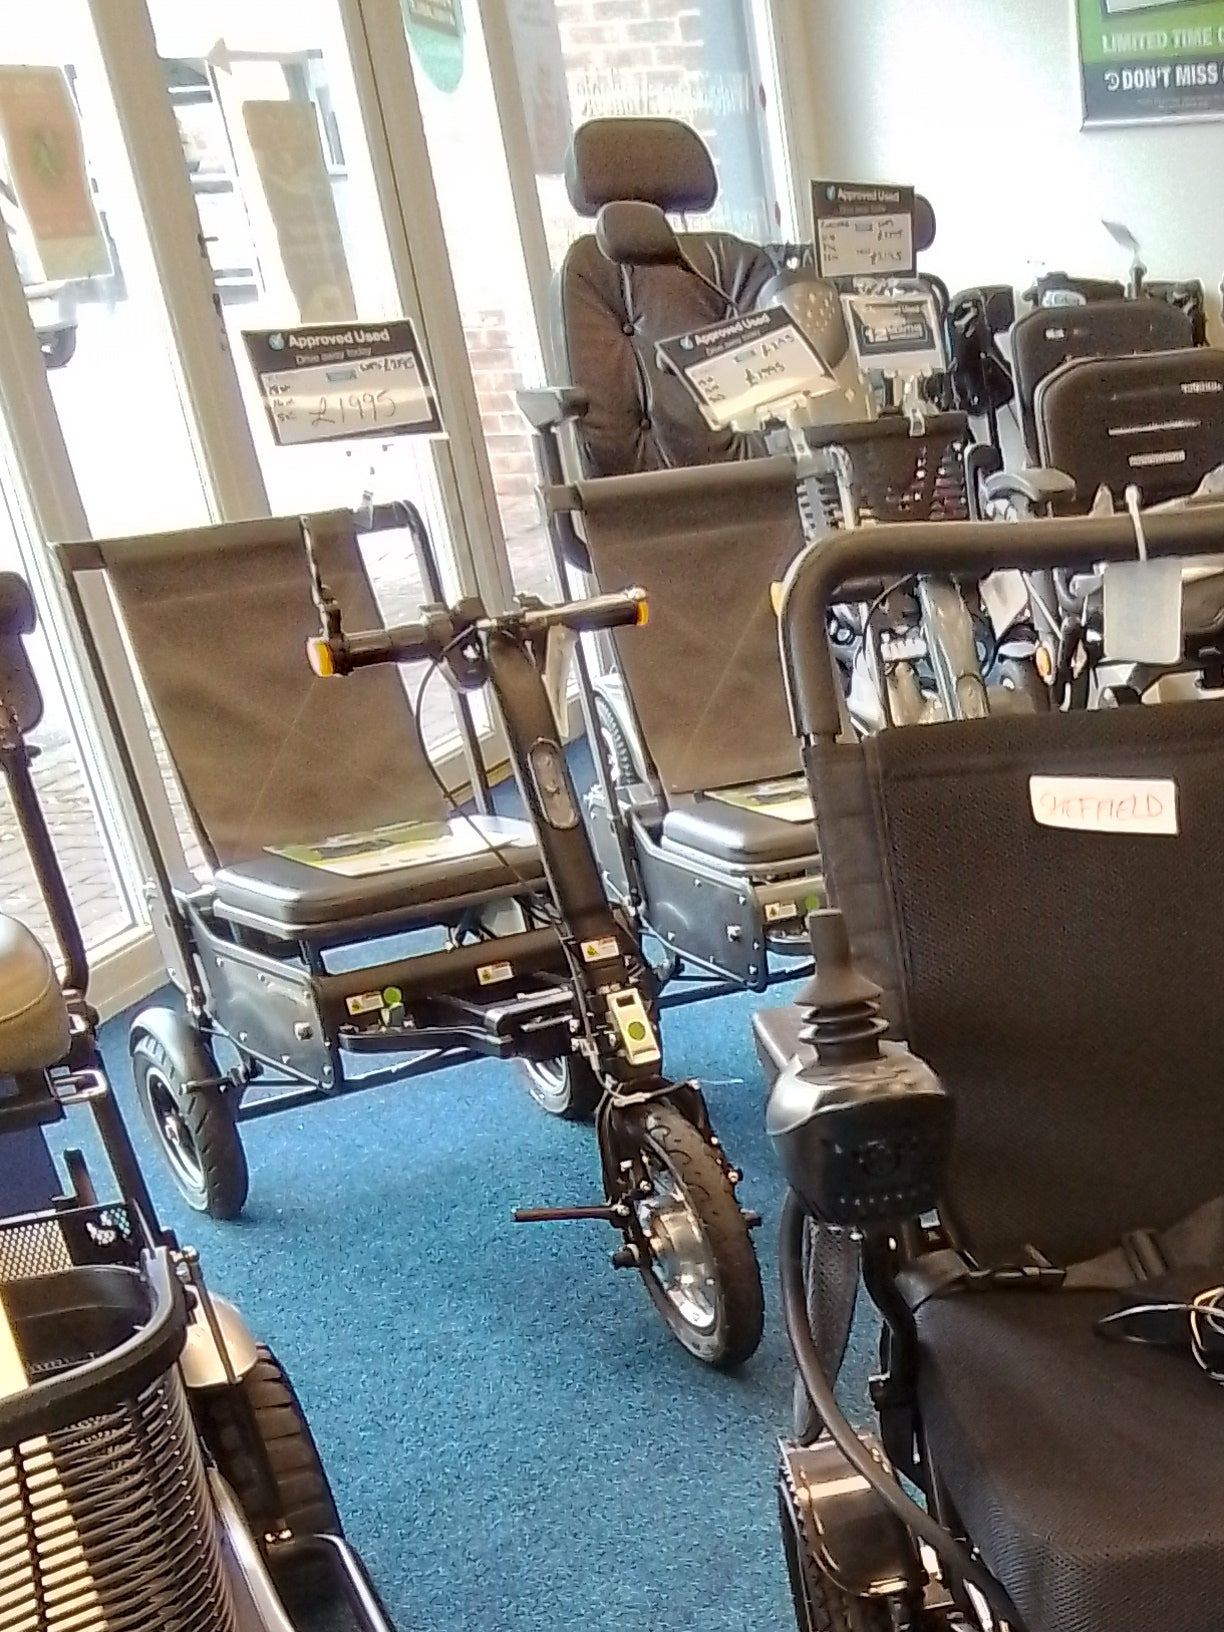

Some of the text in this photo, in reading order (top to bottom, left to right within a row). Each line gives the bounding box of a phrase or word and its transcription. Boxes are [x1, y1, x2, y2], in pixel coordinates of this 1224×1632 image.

[1102, 30, 1168, 53] LIMITED
[1172, 26, 1212, 47] TIME
[1122, 66, 1171, 90] DON'T
[1175, 61, 1218, 86] MISS
[289, 328, 390, 349] Approved Used
[308, 389, 396, 426] £1995
[1040, 792, 1164, 821] SHEFFIELD
